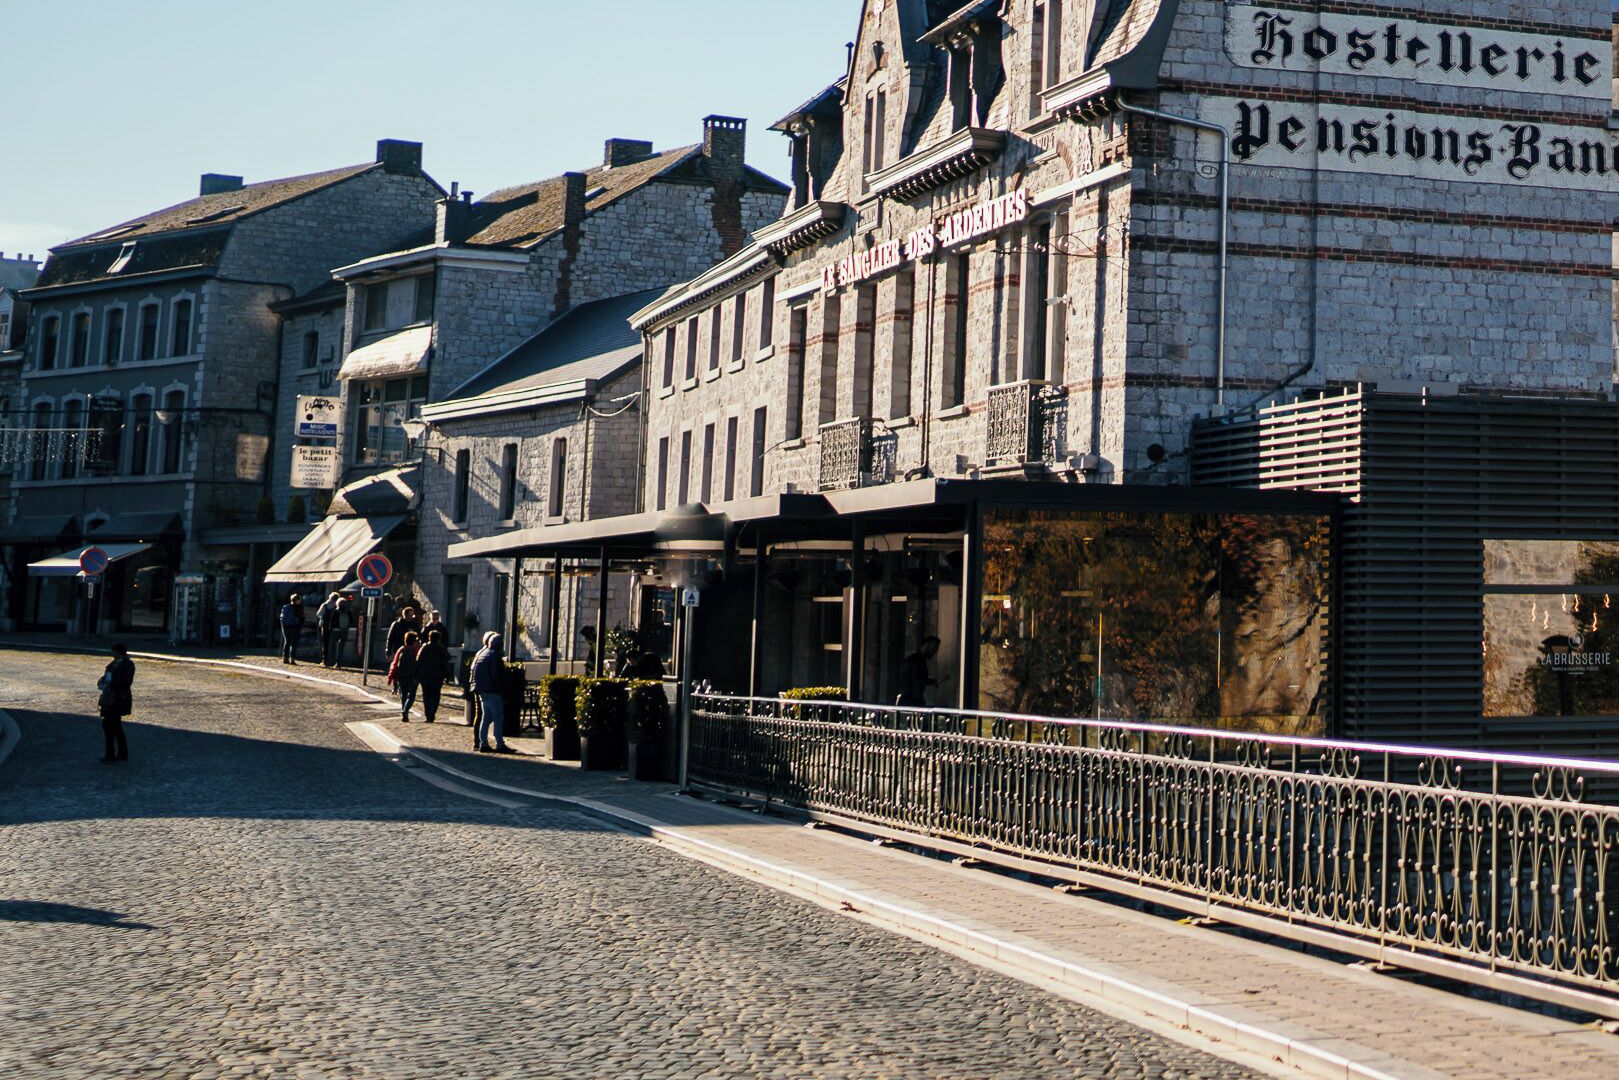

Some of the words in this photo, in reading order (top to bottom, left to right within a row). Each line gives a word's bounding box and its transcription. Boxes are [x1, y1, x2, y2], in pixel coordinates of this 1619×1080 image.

[1251, 10, 1602, 88] Hostellerie
[821, 262, 835, 292] LE
[839, 237, 901, 287] SANGLIER
[906, 223, 935, 261] DES
[938, 188, 1026, 249] ARDENNES
[1541, 653, 1552, 665] LA
